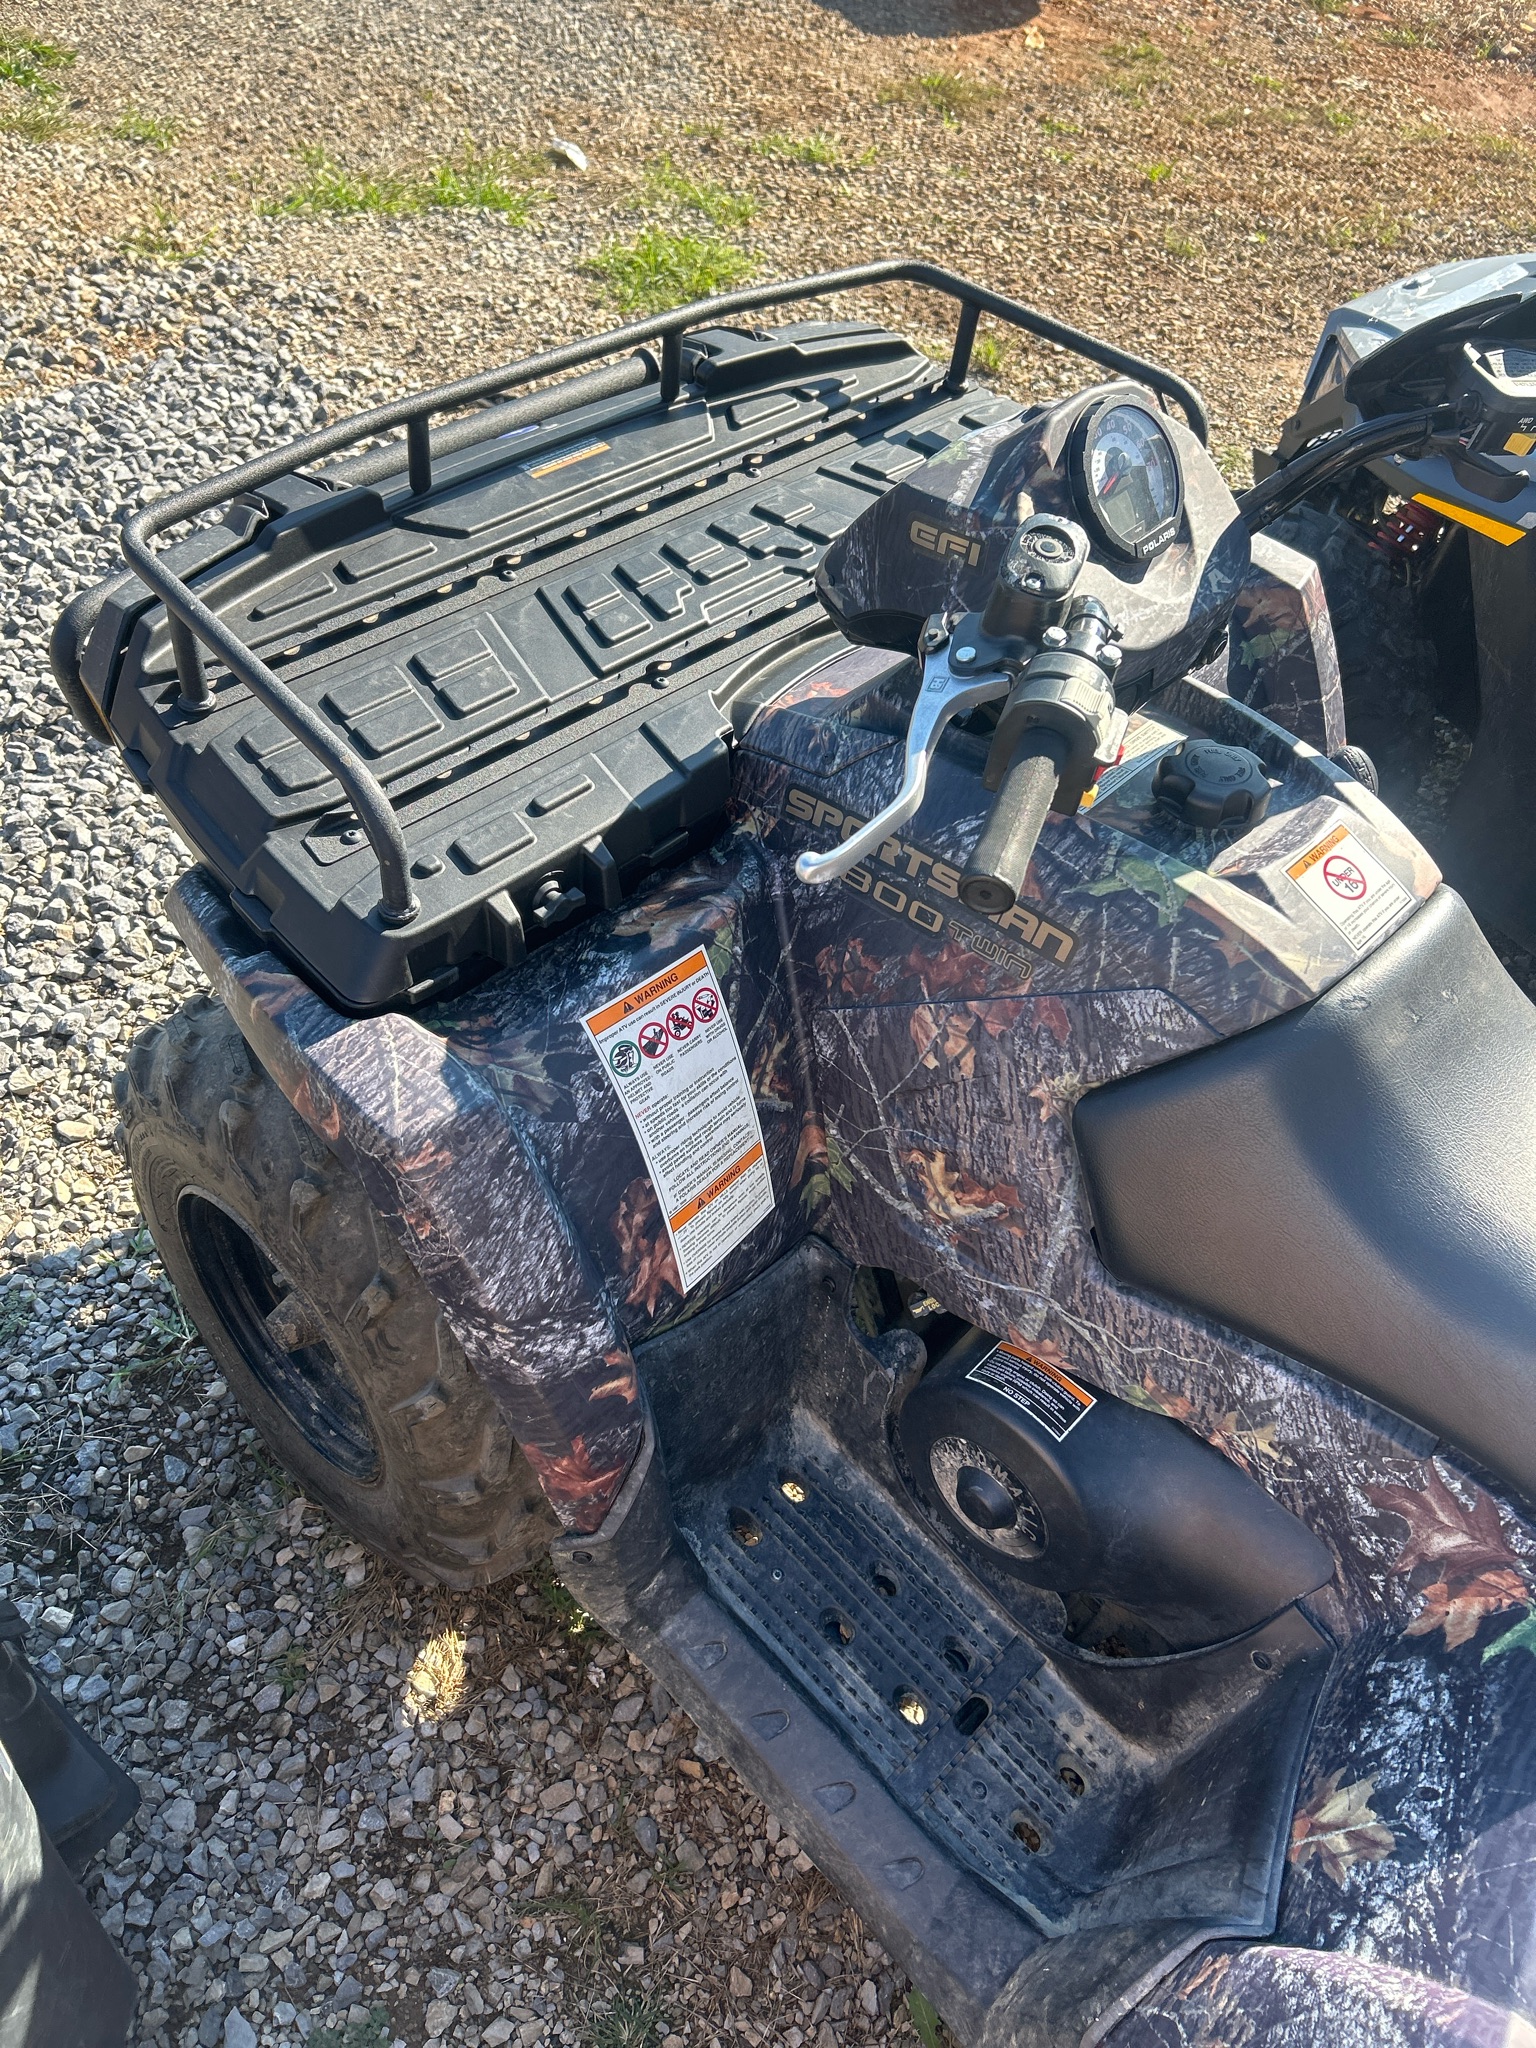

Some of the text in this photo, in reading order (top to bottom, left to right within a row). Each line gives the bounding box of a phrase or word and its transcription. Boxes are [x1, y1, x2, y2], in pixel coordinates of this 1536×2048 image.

[910, 520, 982, 566] EFI
[1142, 528, 1176, 555] POLARIS
[1309, 836, 1340, 862] WARNING
[1332, 866, 1356, 887] UNDER
[634, 972, 678, 1004] WARNING
[679, 1038, 702, 1058] PASSENGERS
[634, 1092, 669, 1120] NEVER operate:
[706, 1166, 741, 1199] WARNING
[1033, 1359, 1062, 1382] WARNING
[1002, 1386, 1030, 1406] NO STEP
